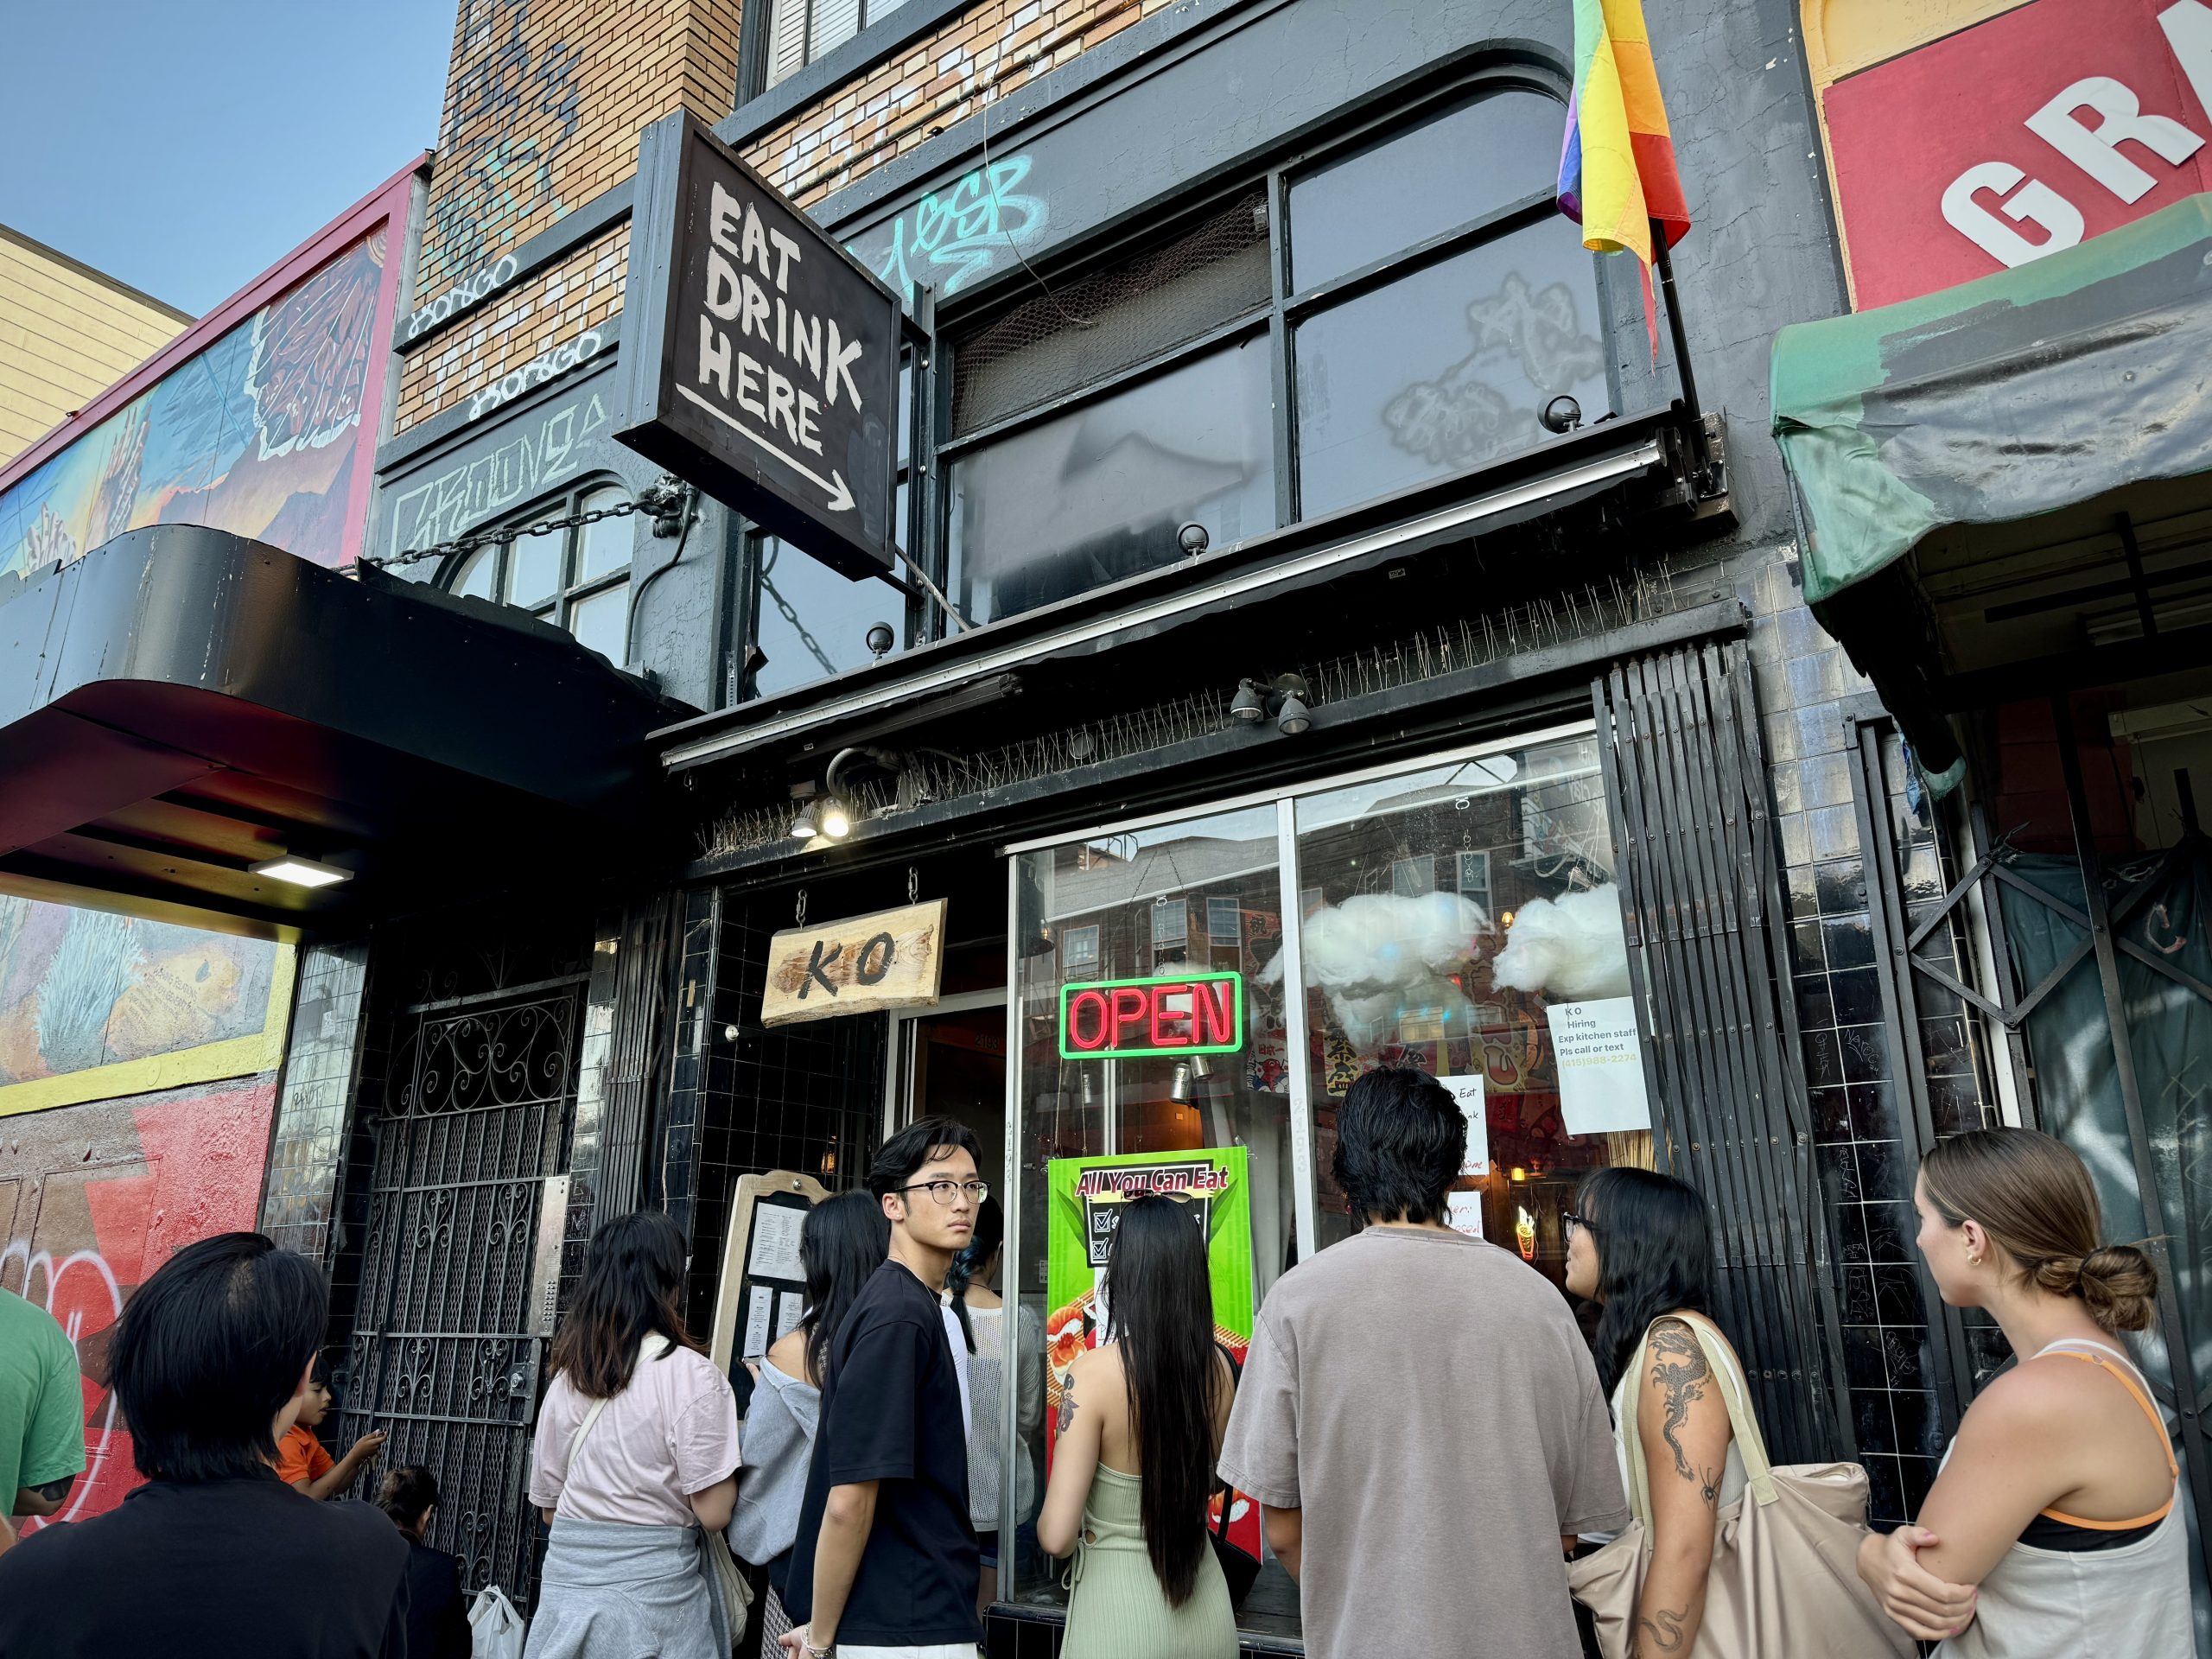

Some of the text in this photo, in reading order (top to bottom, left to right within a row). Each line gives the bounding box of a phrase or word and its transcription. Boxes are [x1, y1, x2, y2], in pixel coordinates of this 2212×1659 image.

[709, 181, 801, 295] EAT
[704, 247, 863, 414] DRINK
[698, 314, 823, 457] HERE
[1071, 982, 1231, 1049] OPEN
[1567, 1020, 1596, 1029] Hiring
[1558, 1028, 1637, 1044] Exp kitchen staff
[1560, 1047, 1573, 1056] Pls
[1574, 1046, 1591, 1054] call
[1605, 1043, 1624, 1052] text
[1459, 1087, 1477, 1098] Eat
[1076, 1166, 1229, 1197] All You Can Eat
